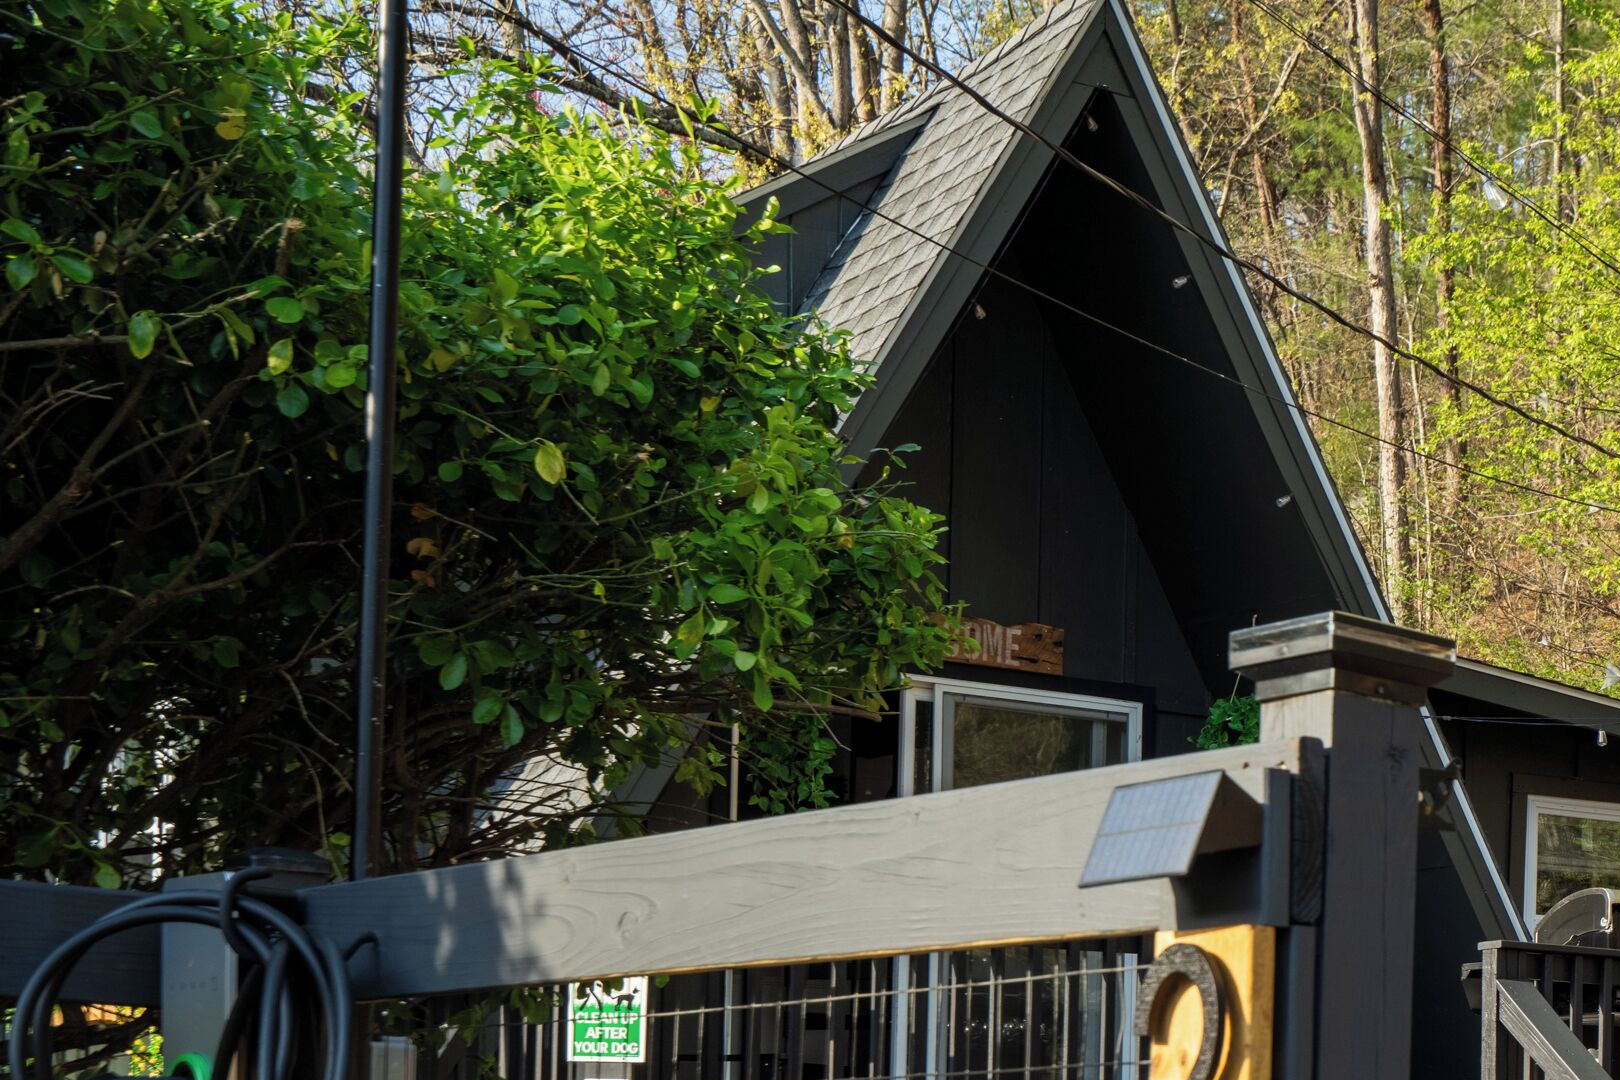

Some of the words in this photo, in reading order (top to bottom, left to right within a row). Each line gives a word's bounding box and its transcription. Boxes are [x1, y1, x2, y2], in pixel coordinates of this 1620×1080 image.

[575, 1012, 618, 1024] CLEAN
[620, 1012, 639, 1025] UP
[584, 1026, 628, 1040] AFTER
[574, 1041, 609, 1054] YOUR
[611, 1042, 639, 1055] DOG
